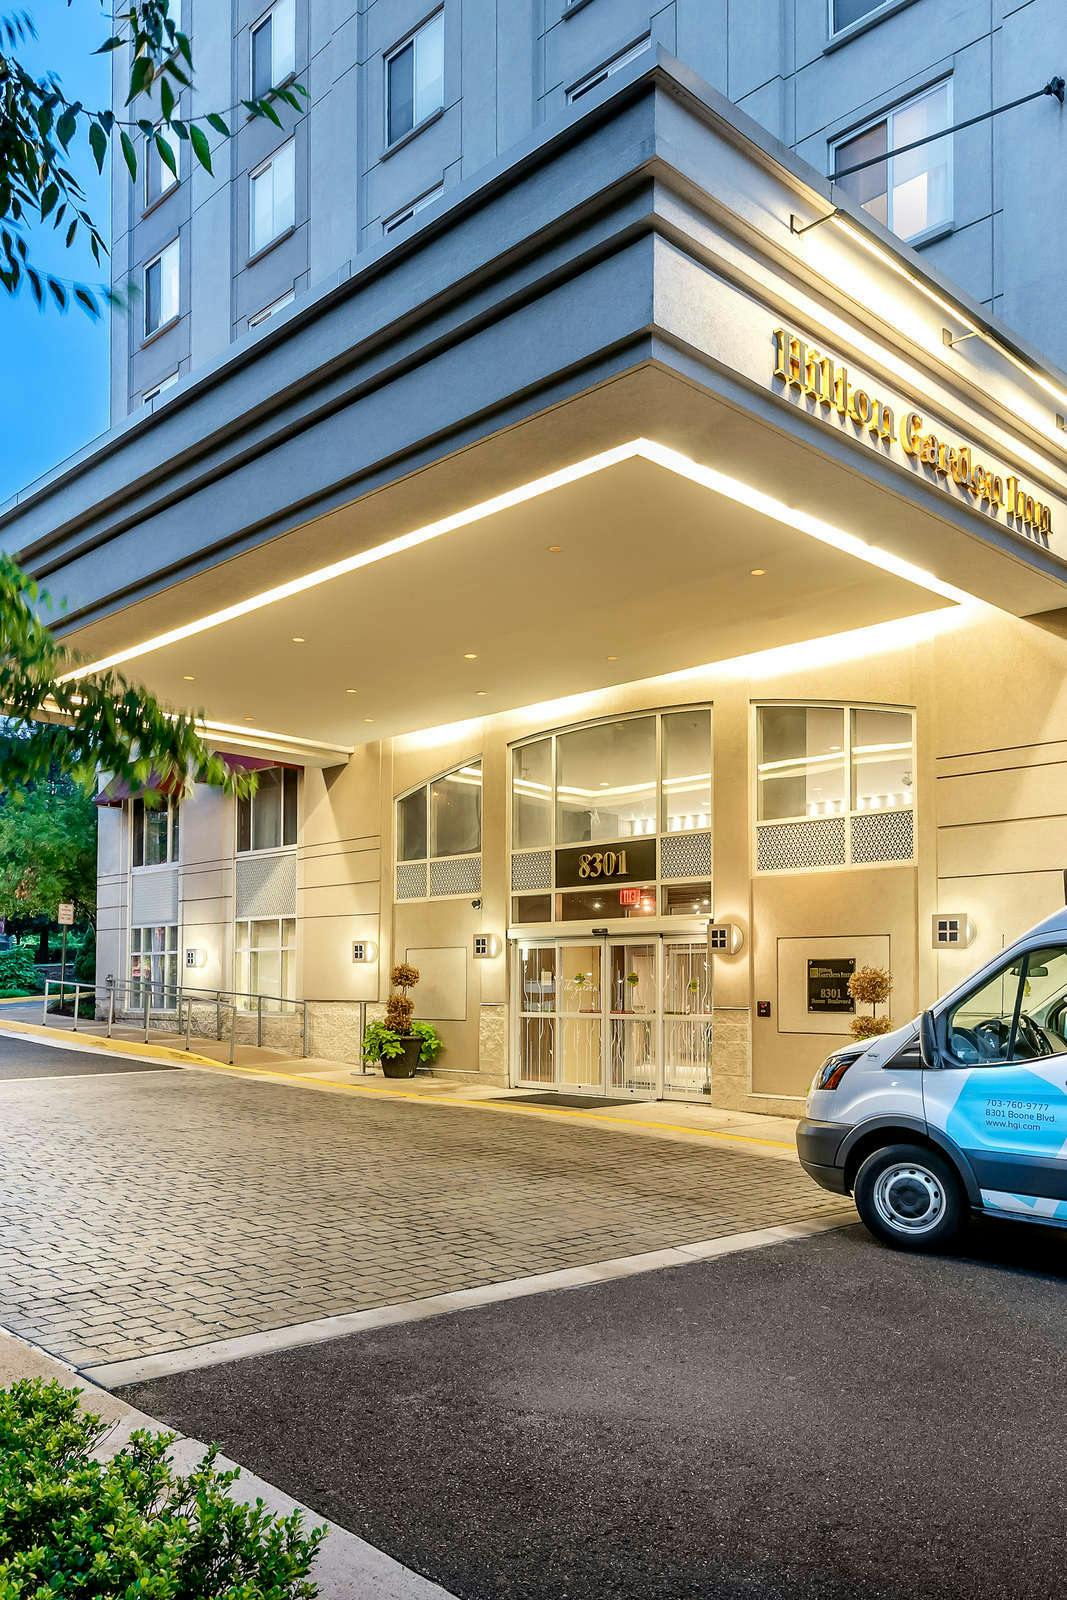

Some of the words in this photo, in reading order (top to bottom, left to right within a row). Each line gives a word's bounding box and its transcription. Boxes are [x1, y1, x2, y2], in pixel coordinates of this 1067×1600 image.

[771, 327, 897, 444] Hilton
[900, 411, 1005, 507] Garden
[1005, 475, 1054, 535] Inn
[578, 849, 630, 878] 8301
[820, 988, 841, 998] 8301
[986, 1098, 1049, 1111] 703-760-9777
[985, 1108, 1006, 1118] 8301
[1007, 1110, 1035, 1121] Boone
[1036, 1113, 1056, 1123] Blvd.
[986, 1119, 1040, 1130] www.hgi.com
